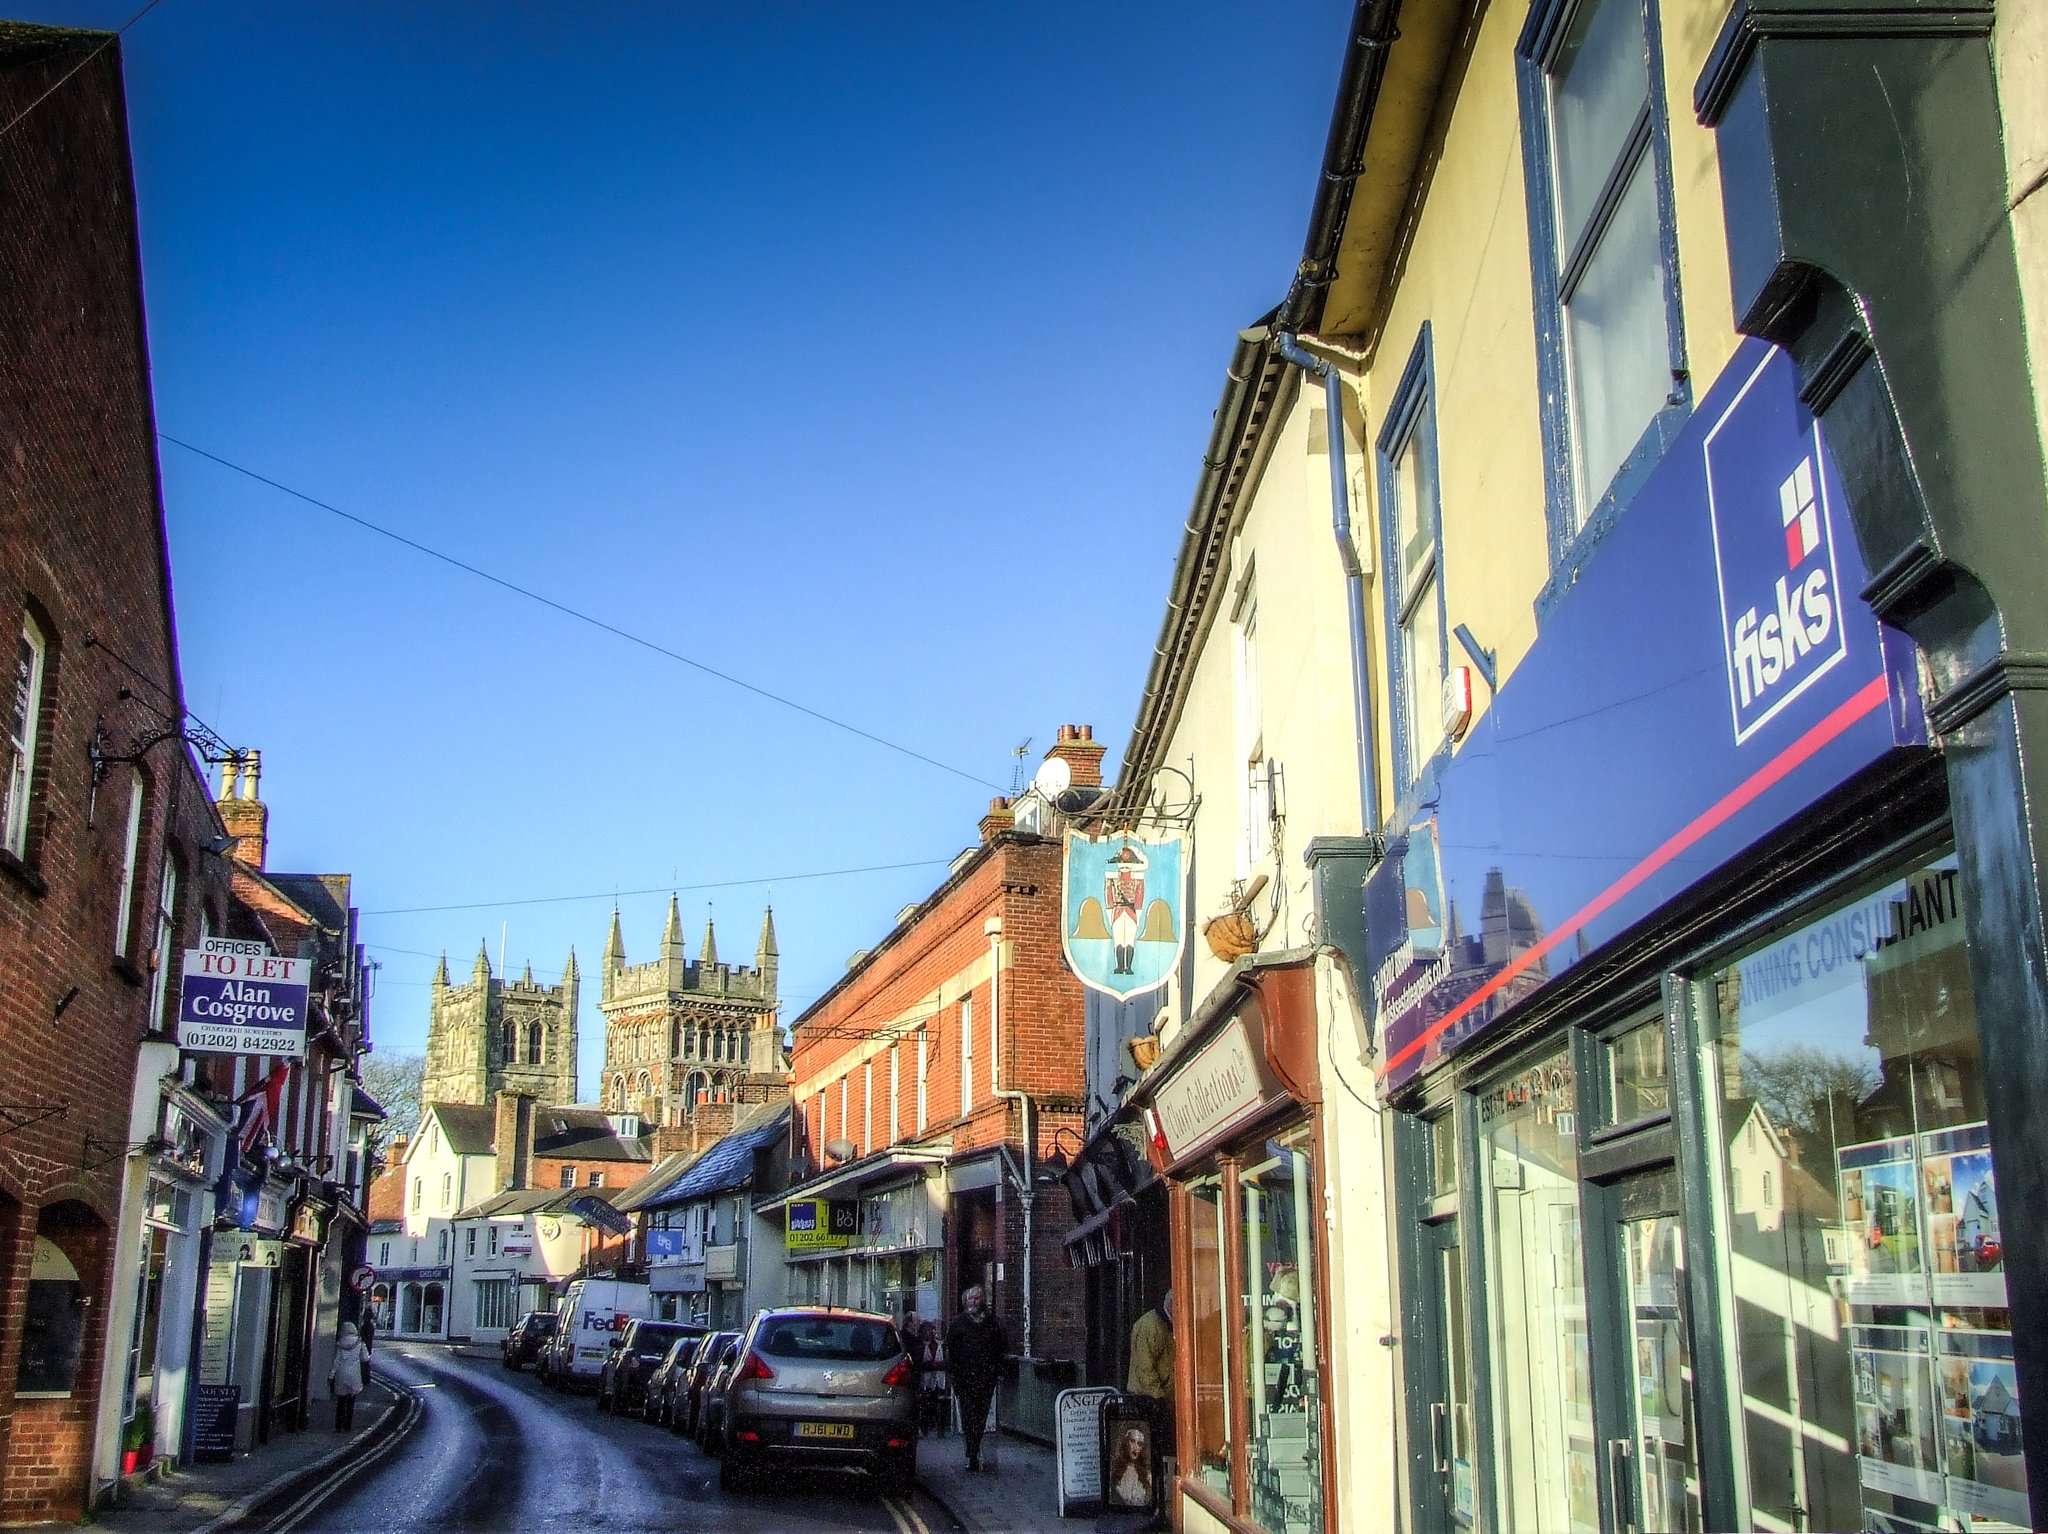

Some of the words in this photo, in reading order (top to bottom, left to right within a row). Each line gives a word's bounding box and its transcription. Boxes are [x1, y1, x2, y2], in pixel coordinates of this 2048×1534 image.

[1733, 568, 1831, 709] fisks
[205, 940, 261, 956] OFFICES
[200, 953, 237, 974] TO
[245, 957, 295, 979] LET
[1742, 942, 1802, 1008] NNING
[220, 981, 271, 1004] Alan
[192, 995, 295, 1025] Cosgrove
[186, 1031, 238, 1050] (01202)
[243, 1037, 296, 1051] 842922
[789, 1233, 814, 1241] 01202
[582, 1310, 630, 1332] FedE
[1063, 1393, 1100, 1411] ANGE
